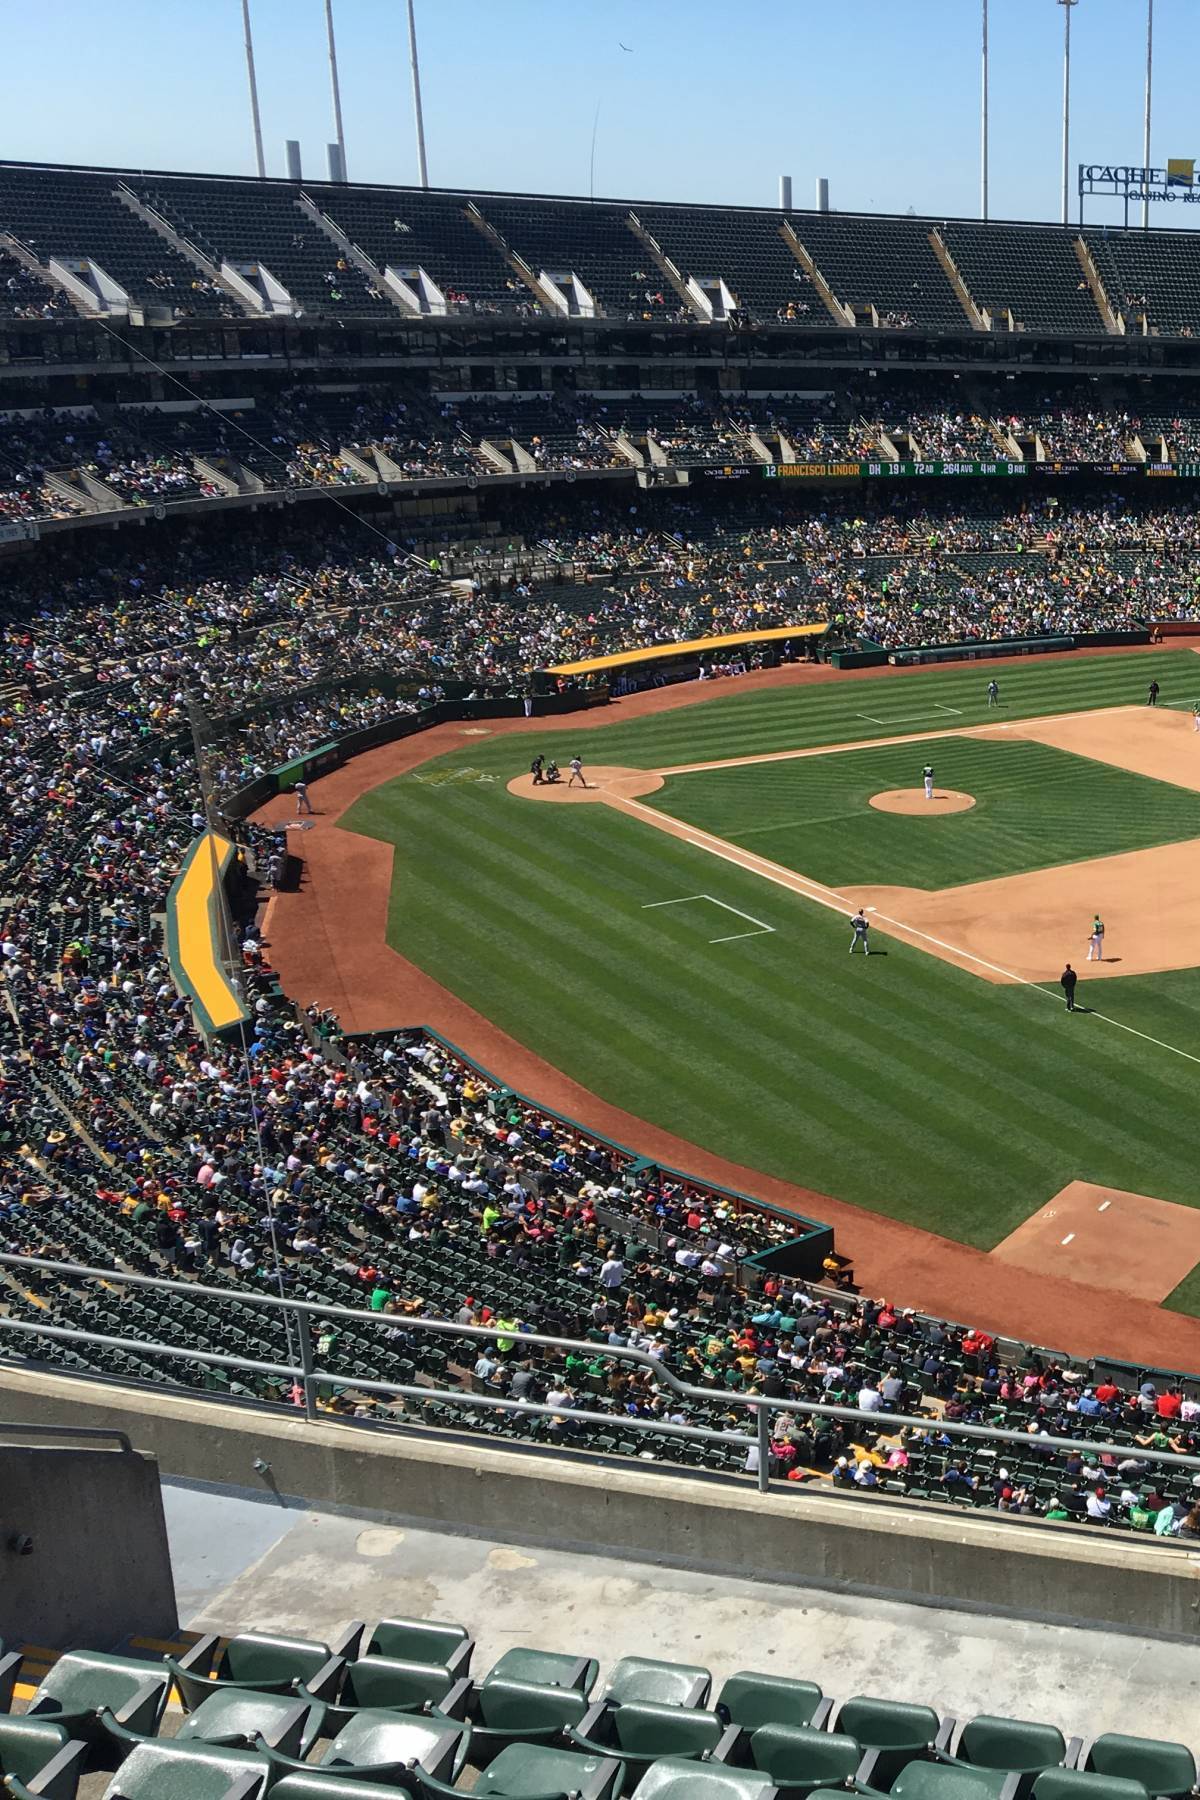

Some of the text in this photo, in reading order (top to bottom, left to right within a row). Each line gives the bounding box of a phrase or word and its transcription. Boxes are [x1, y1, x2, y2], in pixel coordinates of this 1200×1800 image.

[1086, 166, 1161, 183] CACHE
[1129, 190, 1176, 202] CASINO
[766, 465, 776, 477] 12
[778, 464, 825, 476] FRANCISCO
[828, 464, 859, 476] LINDOR
[869, 464, 880, 475] DH
[888, 464, 898, 475] 19
[914, 464, 924, 475] 72
[941, 464, 959, 474] .264
[960, 465, 973, 473] AVG
[980, 464, 987, 474] 4
[987, 464, 996, 473] HR
[1008, 464, 1014, 474] 9
[1014, 465, 1026, 473] RBI
